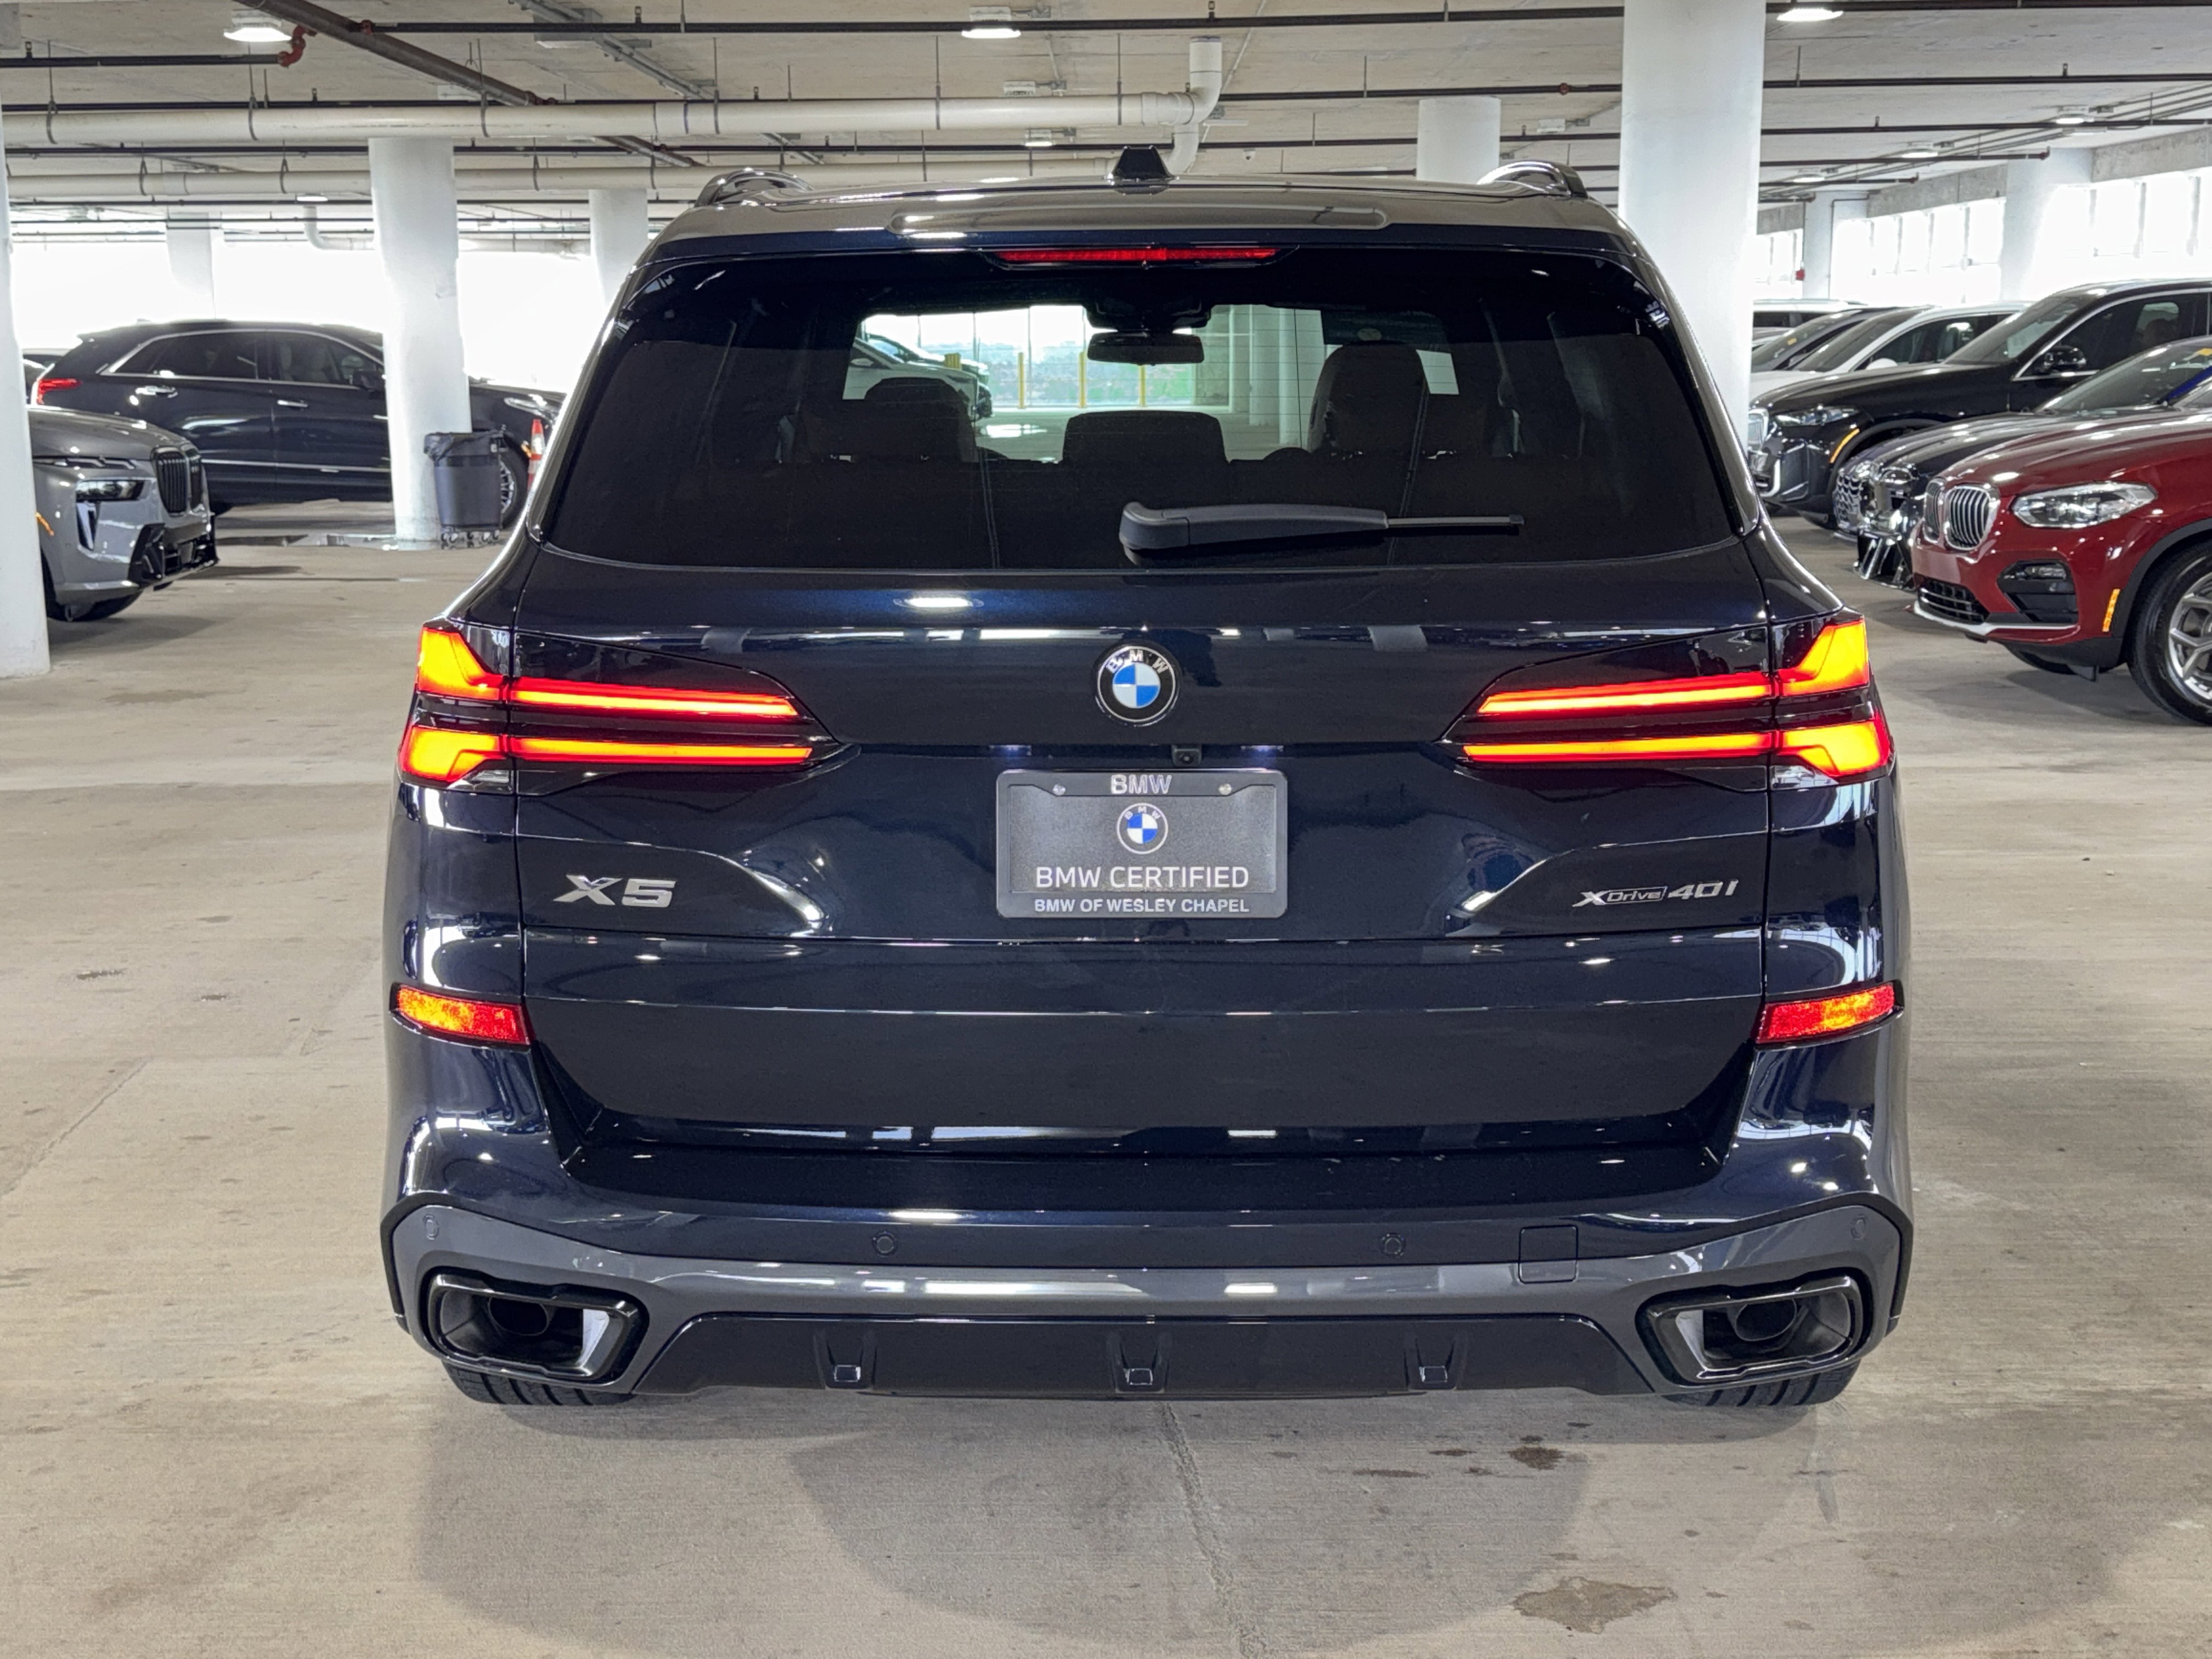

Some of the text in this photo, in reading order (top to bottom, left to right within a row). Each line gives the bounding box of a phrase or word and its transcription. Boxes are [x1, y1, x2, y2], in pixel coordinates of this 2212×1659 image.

[1105, 649, 1169, 673] BMW
[1111, 774, 1172, 794] BMW
[1124, 806, 1161, 820] BMW
[1036, 866, 1249, 888] BMW CERTIFIED
[552, 874, 676, 908] X5
[1035, 898, 1250, 912] BMW OF WESLEY CHAPEL
